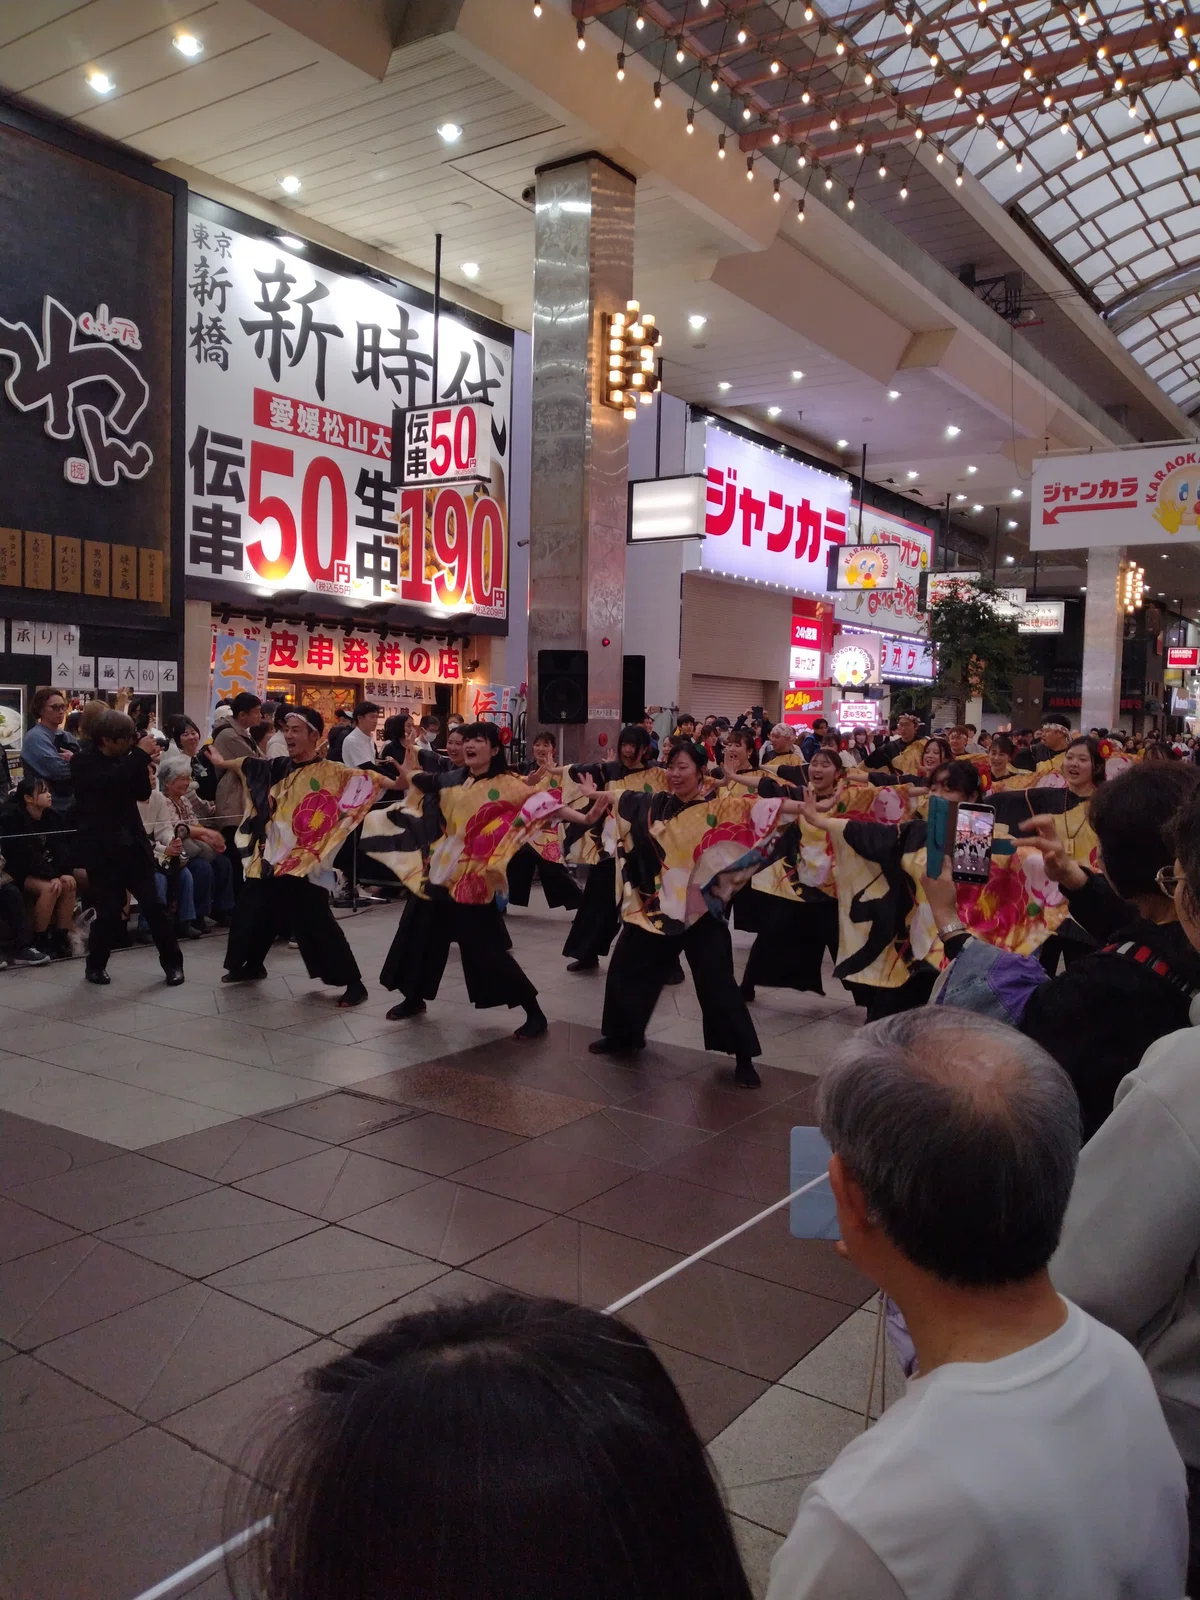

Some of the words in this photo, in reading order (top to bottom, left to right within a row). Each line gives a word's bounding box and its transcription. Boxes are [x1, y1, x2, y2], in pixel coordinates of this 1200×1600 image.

[191, 222, 232, 258] 東京
[188, 255, 233, 372] 新橋
[239, 258, 507, 457] 新時代
[407, 412, 429, 479] 伝串
[188, 425, 246, 575] 伝串
[1043, 477, 1138, 503] ジャンカラ
[1145, 452, 1200, 503] KARAOK
[354, 467, 399, 597] 生中
[705, 466, 847, 568] ジャンカラ
[16, 627, 75, 646] 承り中
[103, 665, 175, 682] 最大60名
[784, 690, 811, 710] 24h
